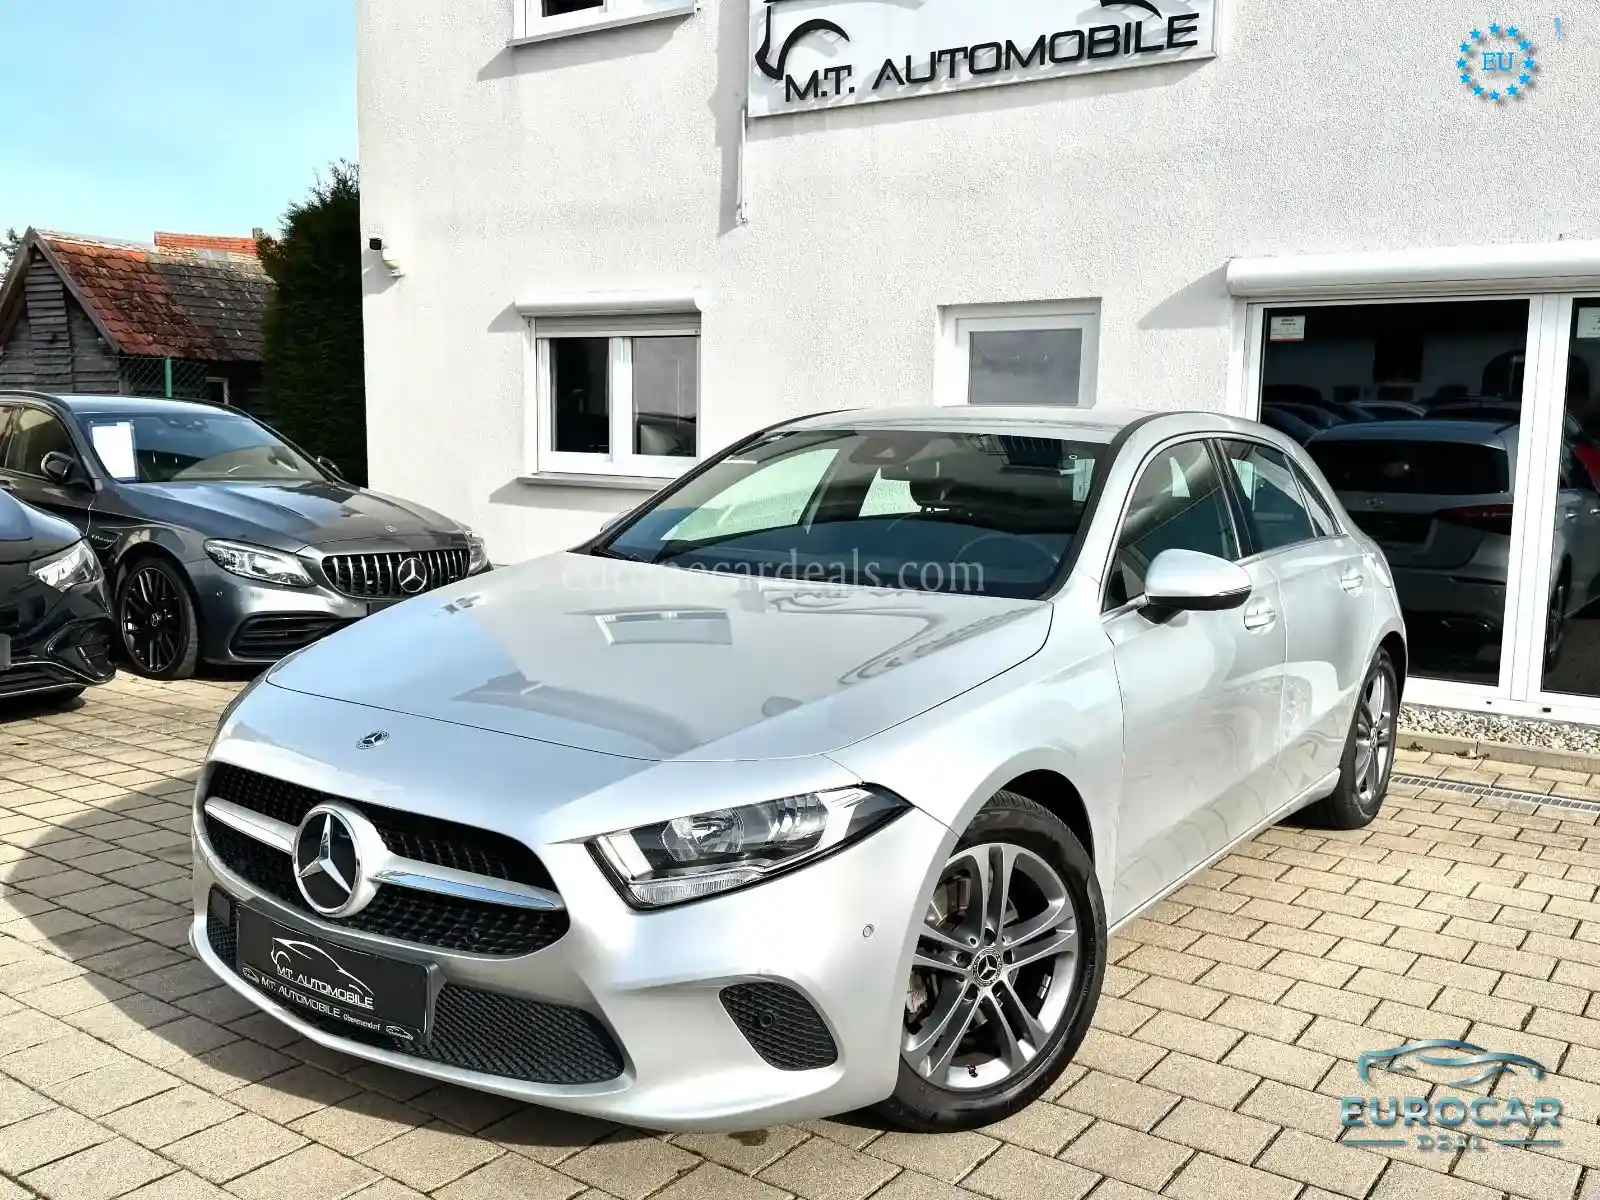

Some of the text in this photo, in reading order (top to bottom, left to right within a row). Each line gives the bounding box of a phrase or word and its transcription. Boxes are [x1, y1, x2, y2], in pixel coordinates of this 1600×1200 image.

[784, 12, 1200, 102] M.T. AUTOMOBILE
[276, 963, 294, 981] M.T.
[296, 973, 375, 1009] AUTOMOBILE
[278, 985, 341, 1018] AUTOMOBILE
